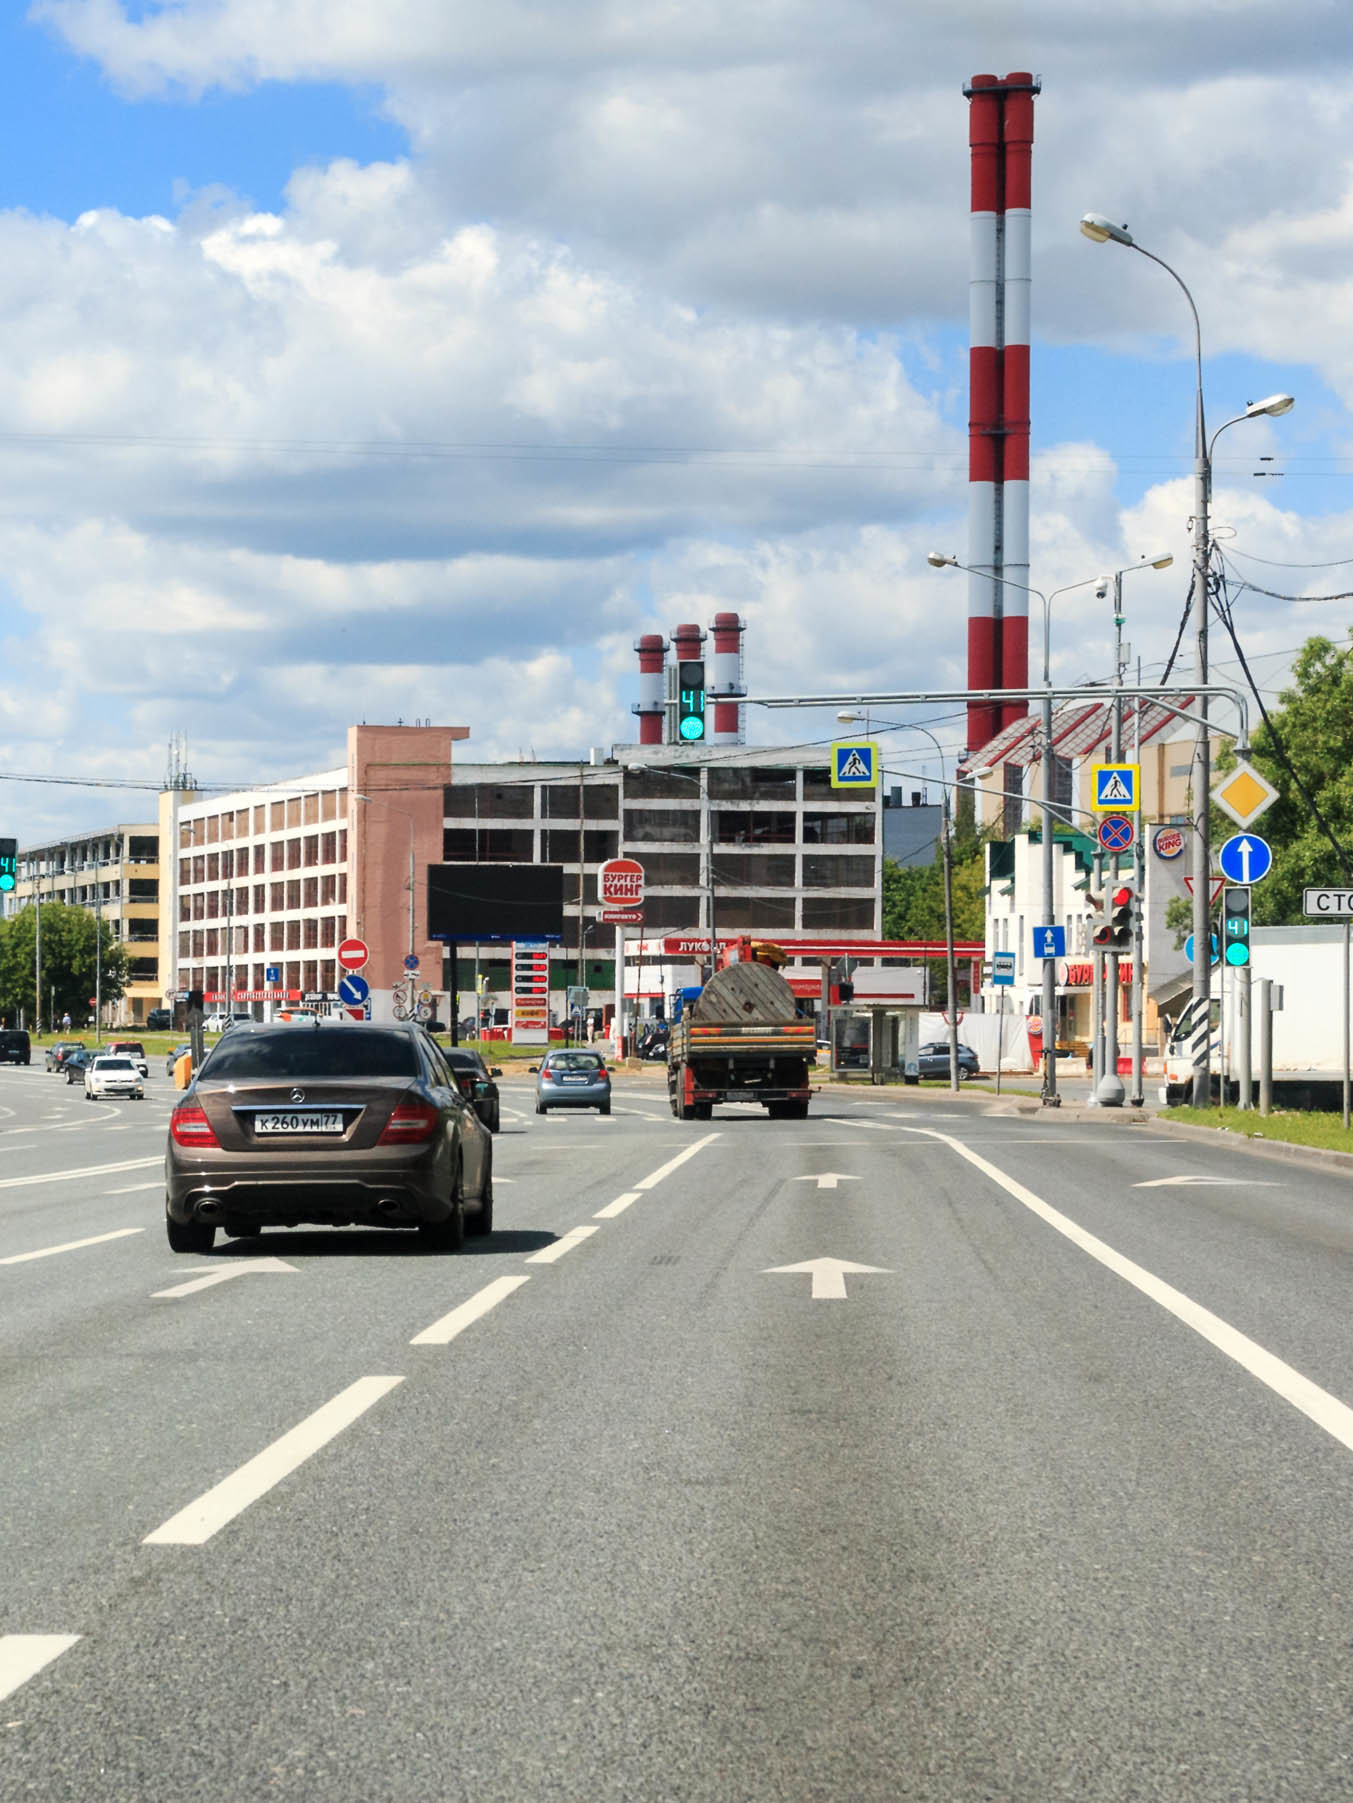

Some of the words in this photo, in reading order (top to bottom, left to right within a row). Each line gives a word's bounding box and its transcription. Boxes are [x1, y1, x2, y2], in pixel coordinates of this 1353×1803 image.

[682, 690, 704, 712] 41
[1159, 837, 1181, 852] KING
[0, 856, 16, 873] 41
[603, 873, 643, 883] БУРГЕР
[603, 883, 643, 896] КИНГ
[1228, 919, 1248, 935] 41
[679, 940, 727, 952] ЛУКОЛ
[260, 1116, 322, 1131] К260УМ
[324, 1114, 338, 1126] 77
